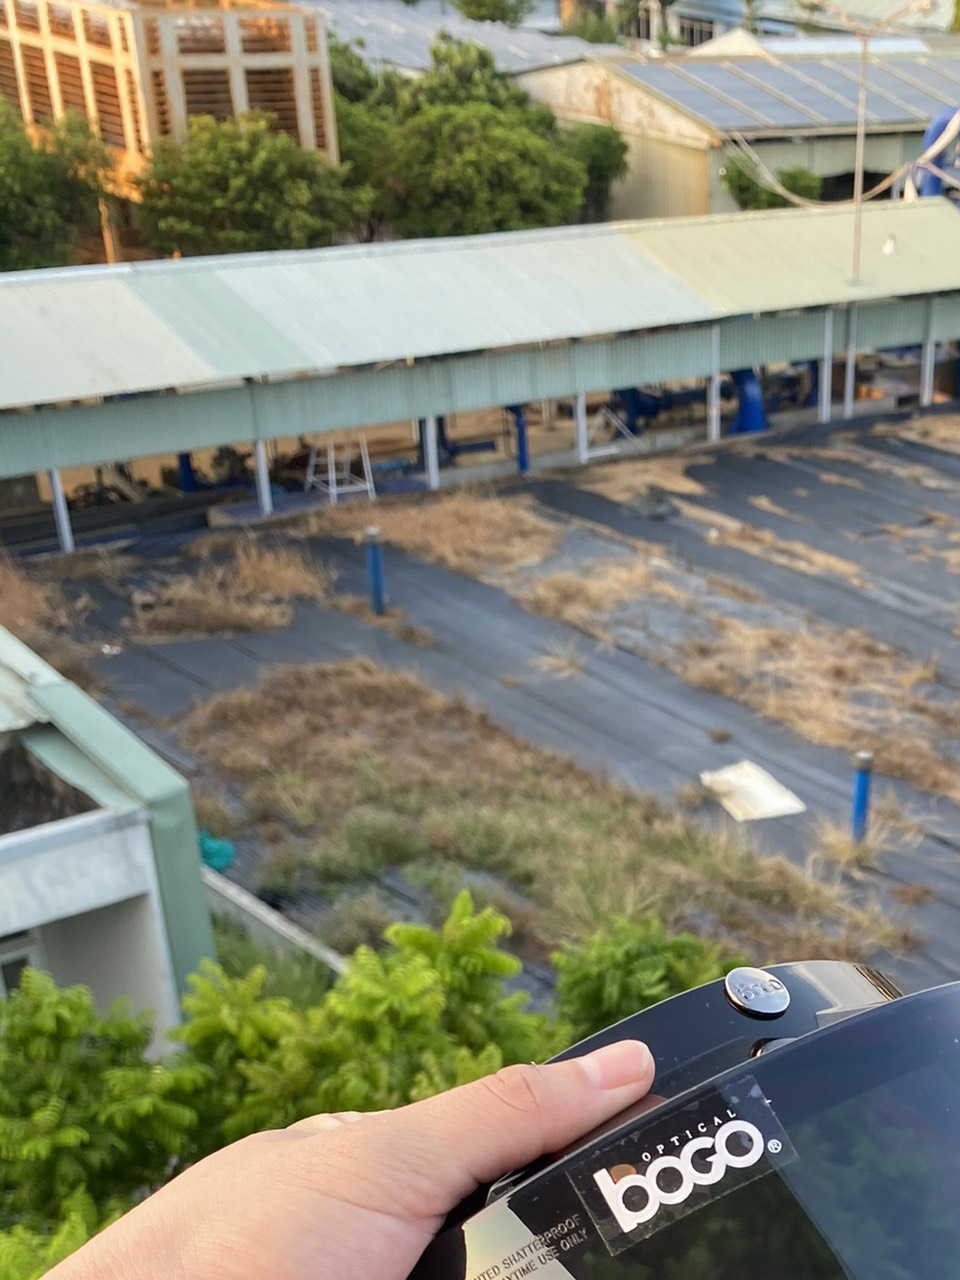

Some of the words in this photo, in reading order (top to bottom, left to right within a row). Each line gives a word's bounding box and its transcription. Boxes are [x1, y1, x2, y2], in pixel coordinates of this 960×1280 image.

[641, 1108, 737, 1162] OPTICAL
[502, 1213, 581, 1269] SHATTERPROOF
[538, 1245, 560, 1265] USE
[560, 1227, 588, 1251] ONLY
